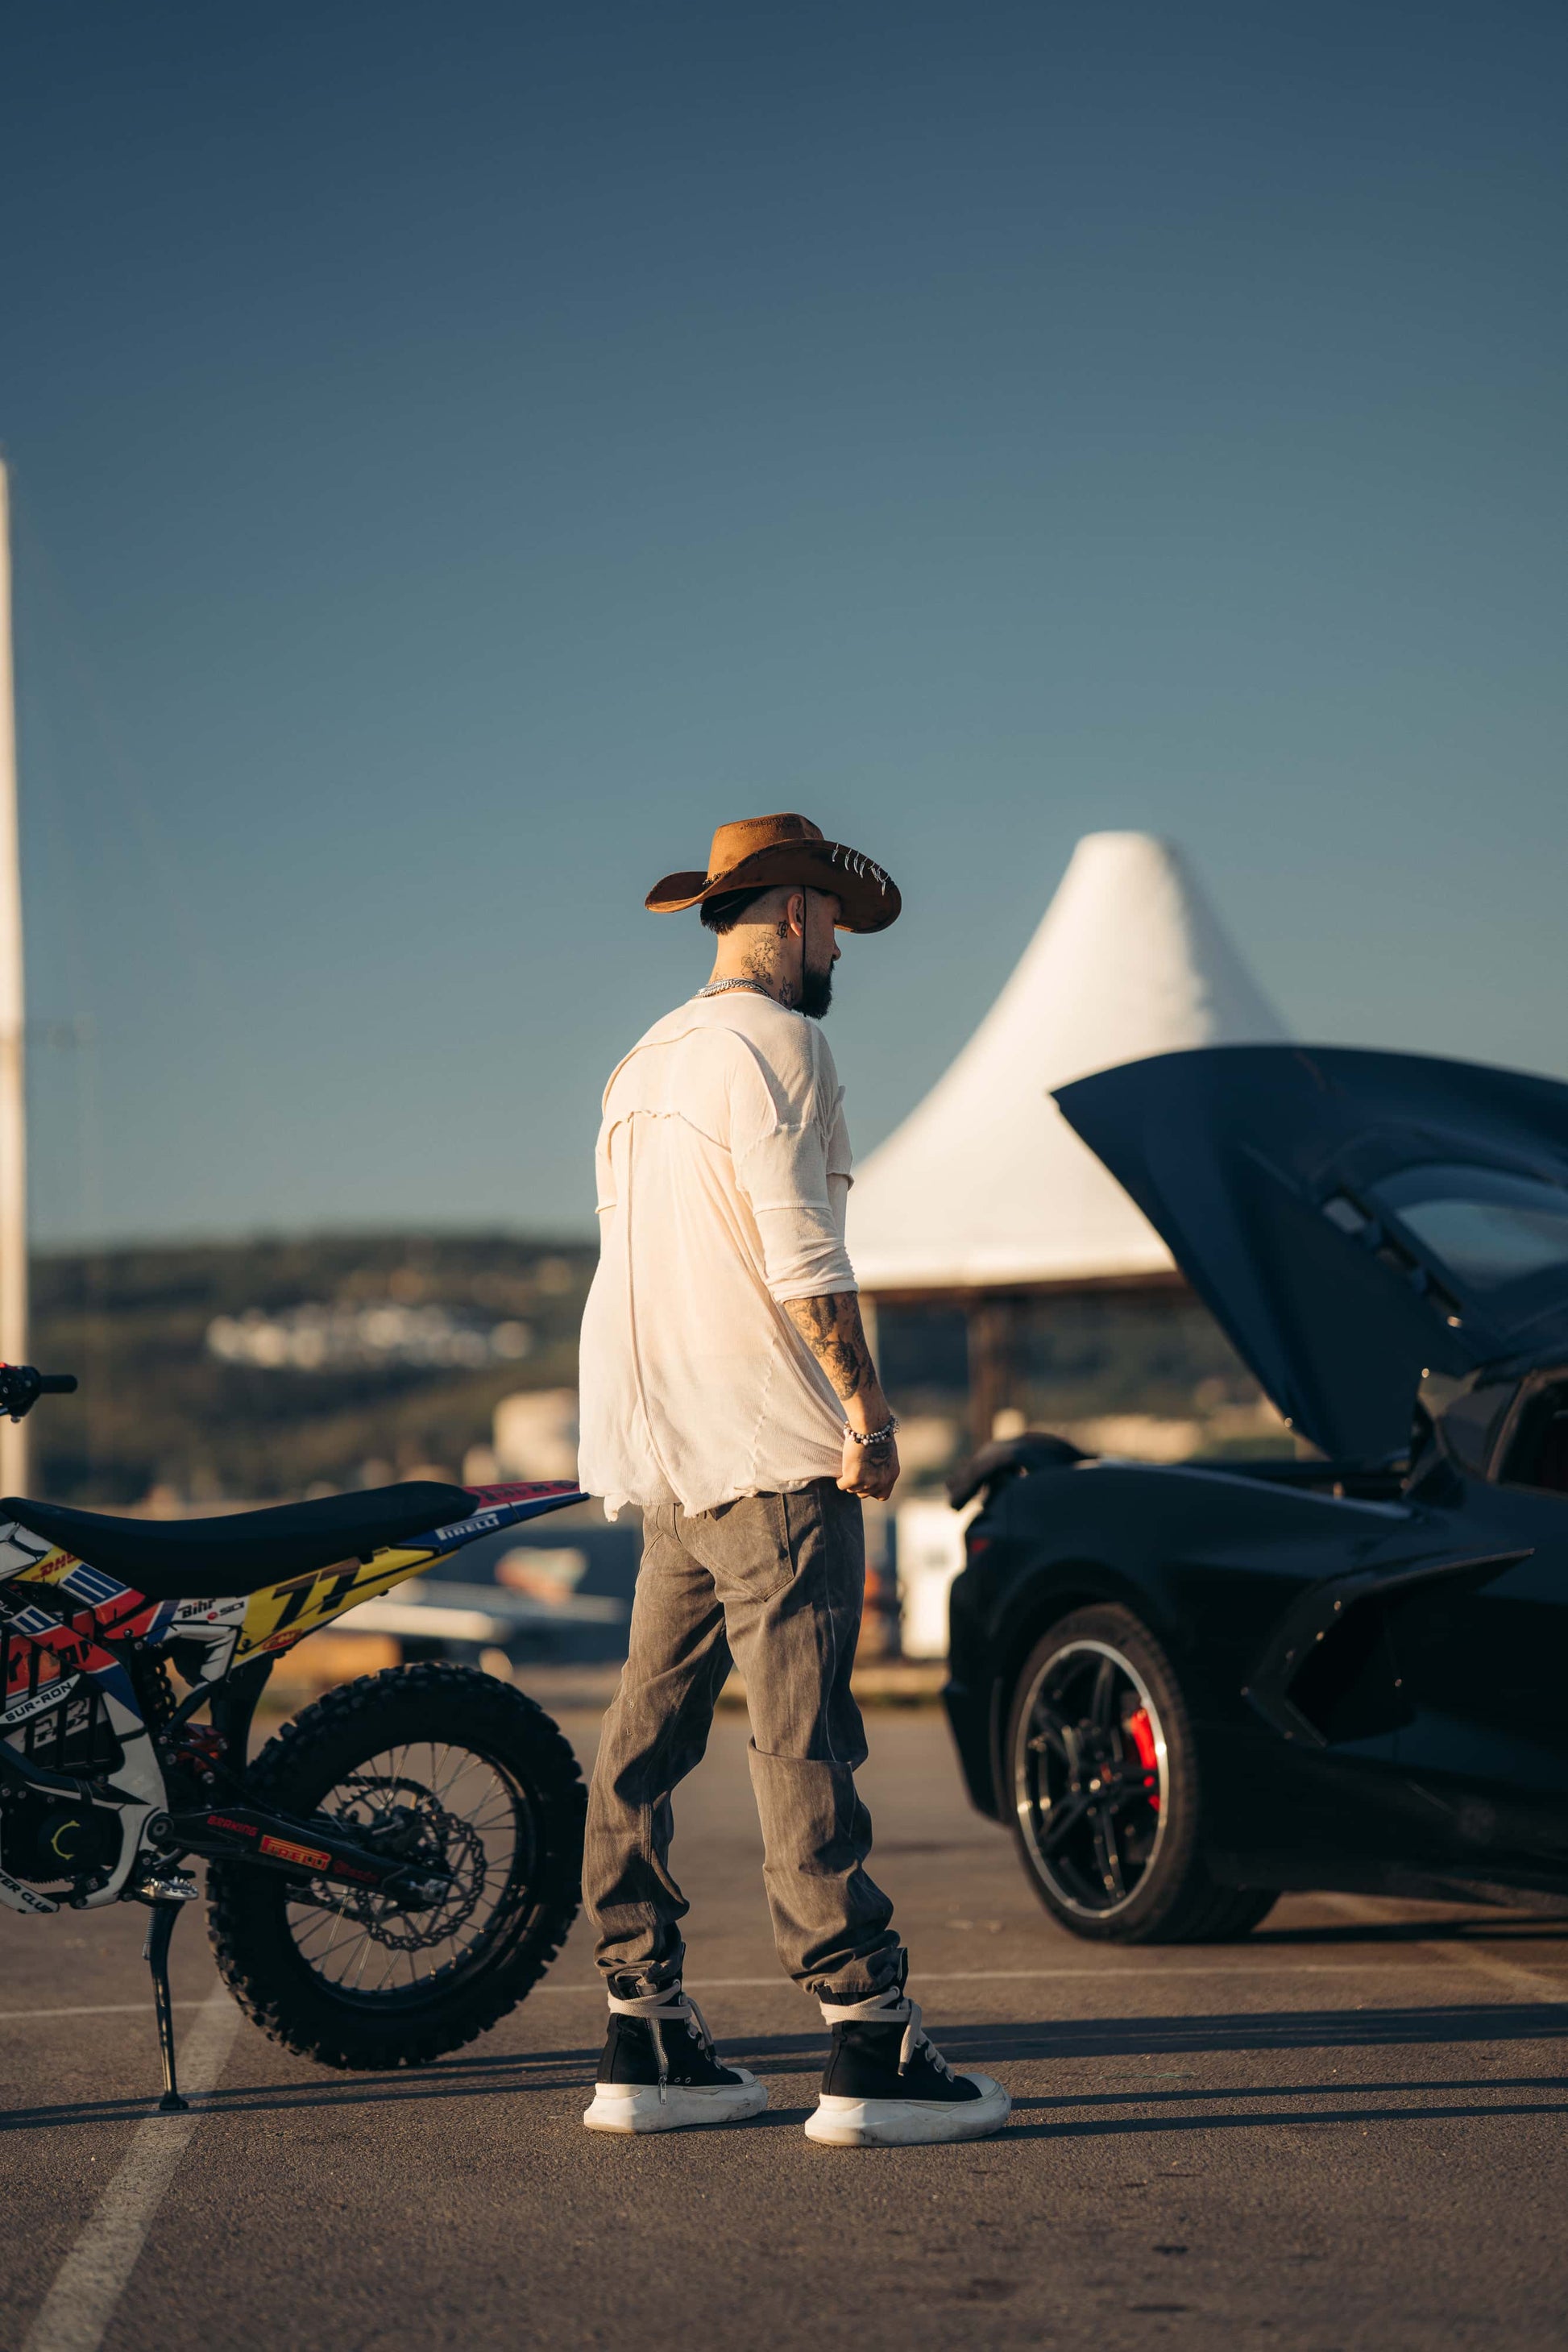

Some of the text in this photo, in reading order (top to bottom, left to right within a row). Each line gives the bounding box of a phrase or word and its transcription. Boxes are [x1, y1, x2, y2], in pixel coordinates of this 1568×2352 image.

[434, 1512, 500, 1541] PIRELLI
[39, 1552, 77, 1578] DHL
[178, 1599, 216, 1618] Bihr
[6, 1682, 73, 1722] SUR-RON
[259, 1836, 331, 1871] PIRELLI
